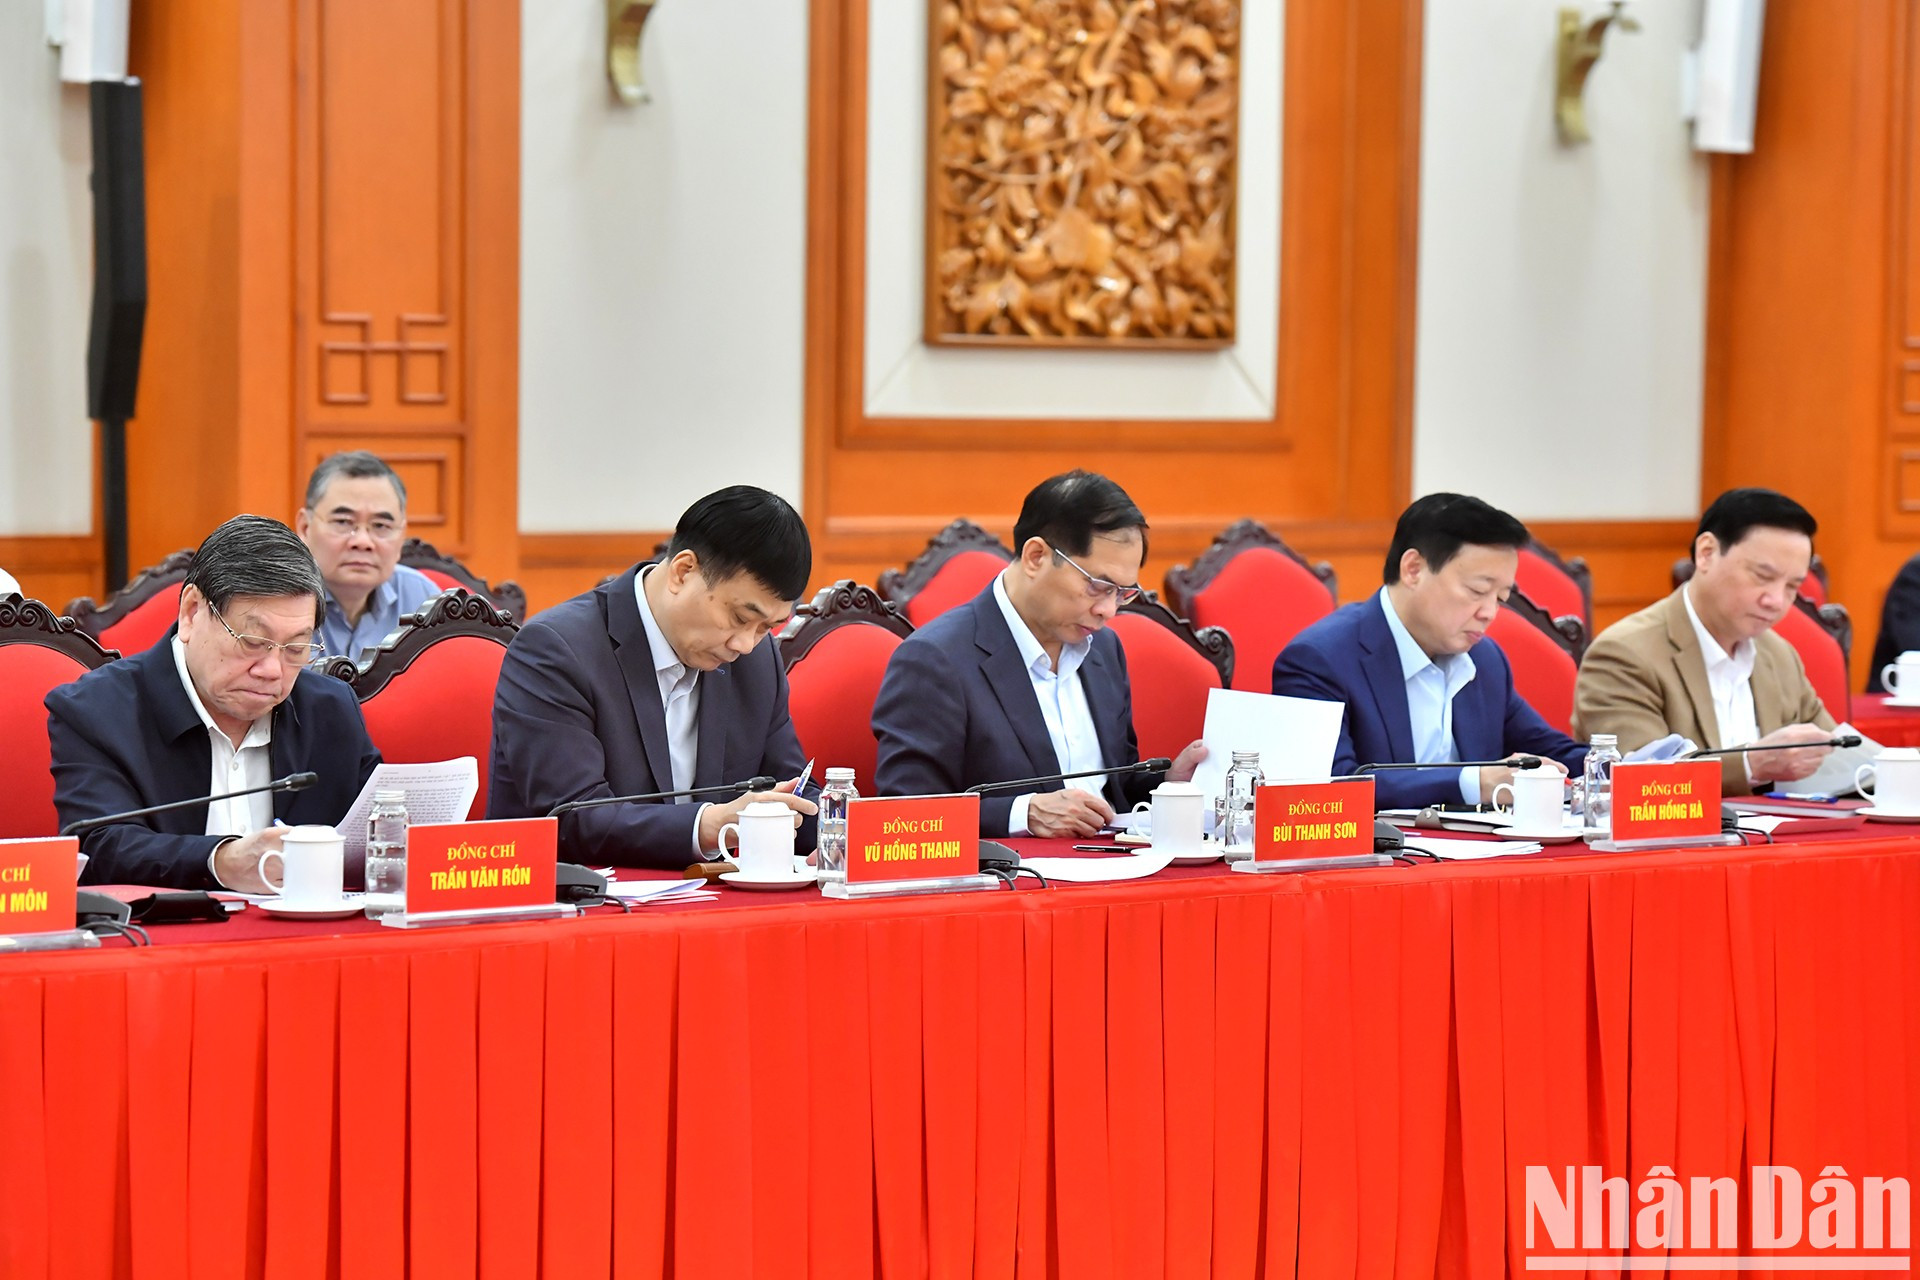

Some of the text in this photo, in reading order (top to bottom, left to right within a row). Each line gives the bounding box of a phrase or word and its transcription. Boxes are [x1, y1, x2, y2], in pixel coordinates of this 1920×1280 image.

[1642, 780, 1692, 797] ĐỒNG CHÍ
[1288, 799, 1343, 816] ĐỒNG CHÍ
[1689, 800, 1703, 819] HÀ
[883, 816, 944, 835] ĐỒNG CHÍ
[1273, 821, 1357, 843] BÙI THANH SƠN
[447, 841, 516, 861] ĐỒNG CHÍ
[864, 838, 961, 863] VŨ HỒNG THANH
[2, 863, 31, 883] CHÍ
[470, 866, 498, 888] VĂN
[502, 864, 531, 886] RÓN
[10, 888, 48, 913] MÔN
